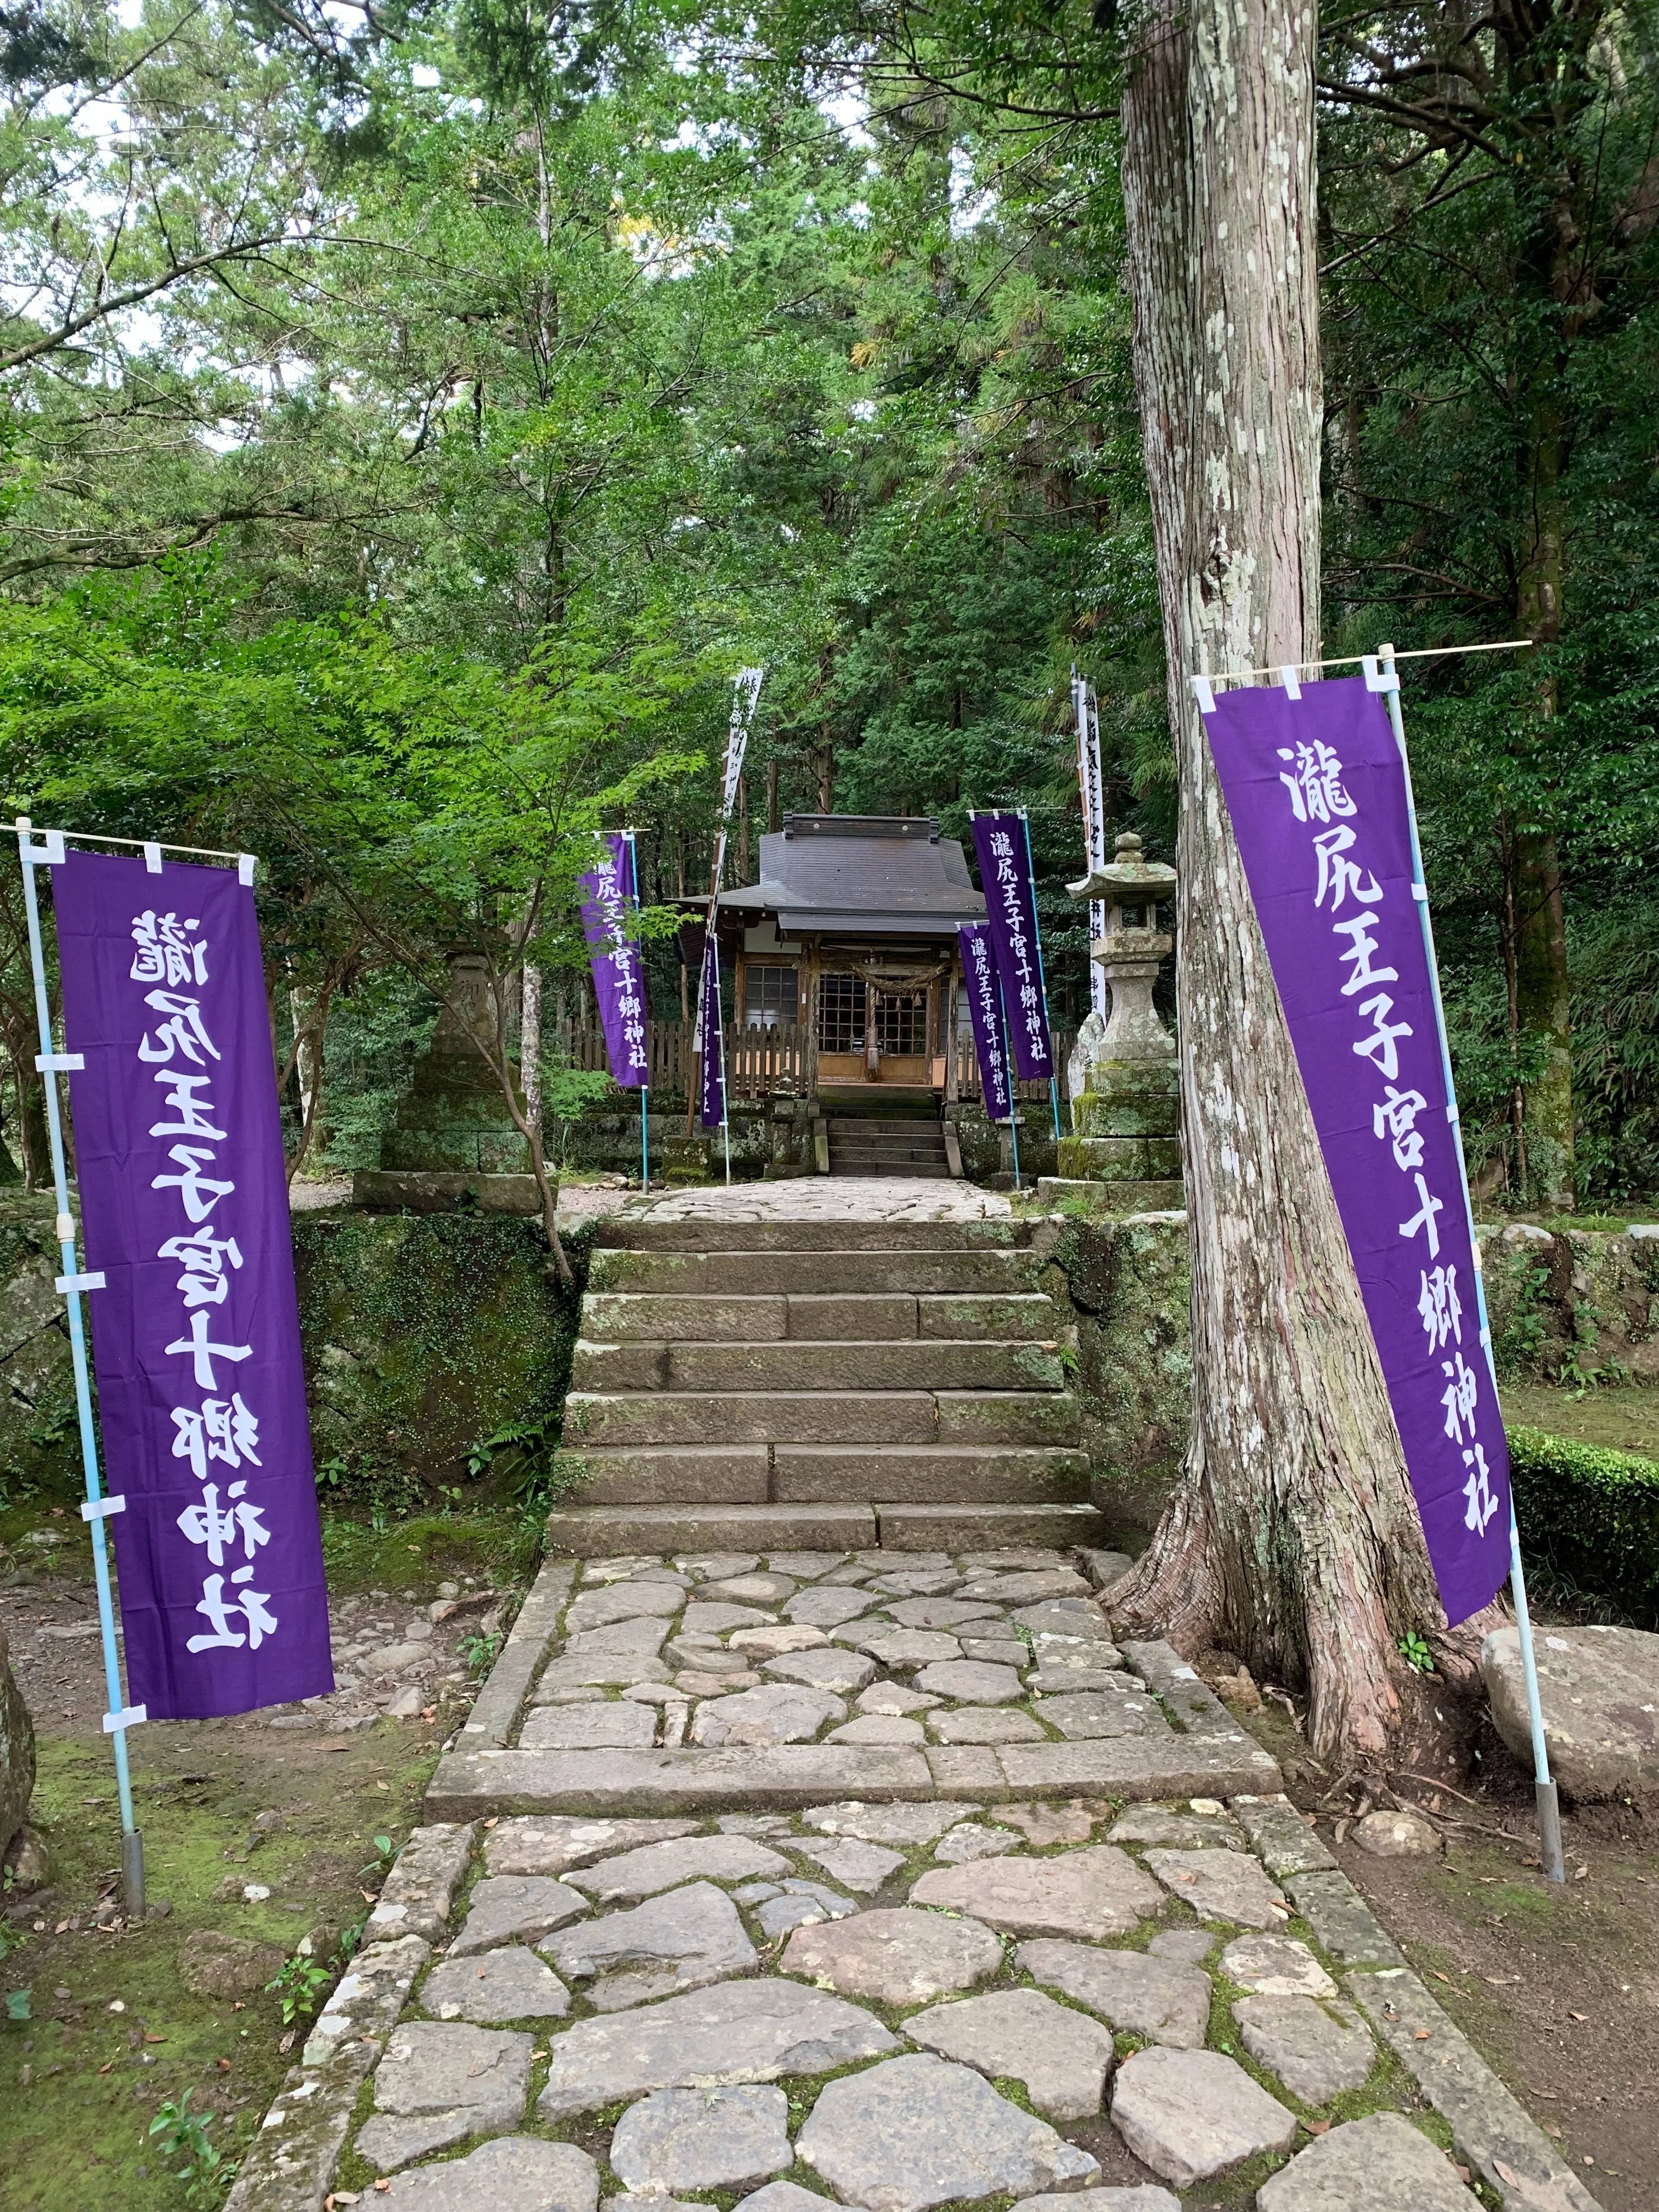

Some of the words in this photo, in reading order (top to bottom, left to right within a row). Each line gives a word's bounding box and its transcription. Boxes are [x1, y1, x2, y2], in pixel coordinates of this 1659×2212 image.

[970, 938, 1007, 1105] 瀧尻王子宮十郷神社
[990, 832, 1047, 1061] 瀧尻王子宮十郷神社
[1277, 738, 1499, 1538] 瀧尻王子宮十郷神社
